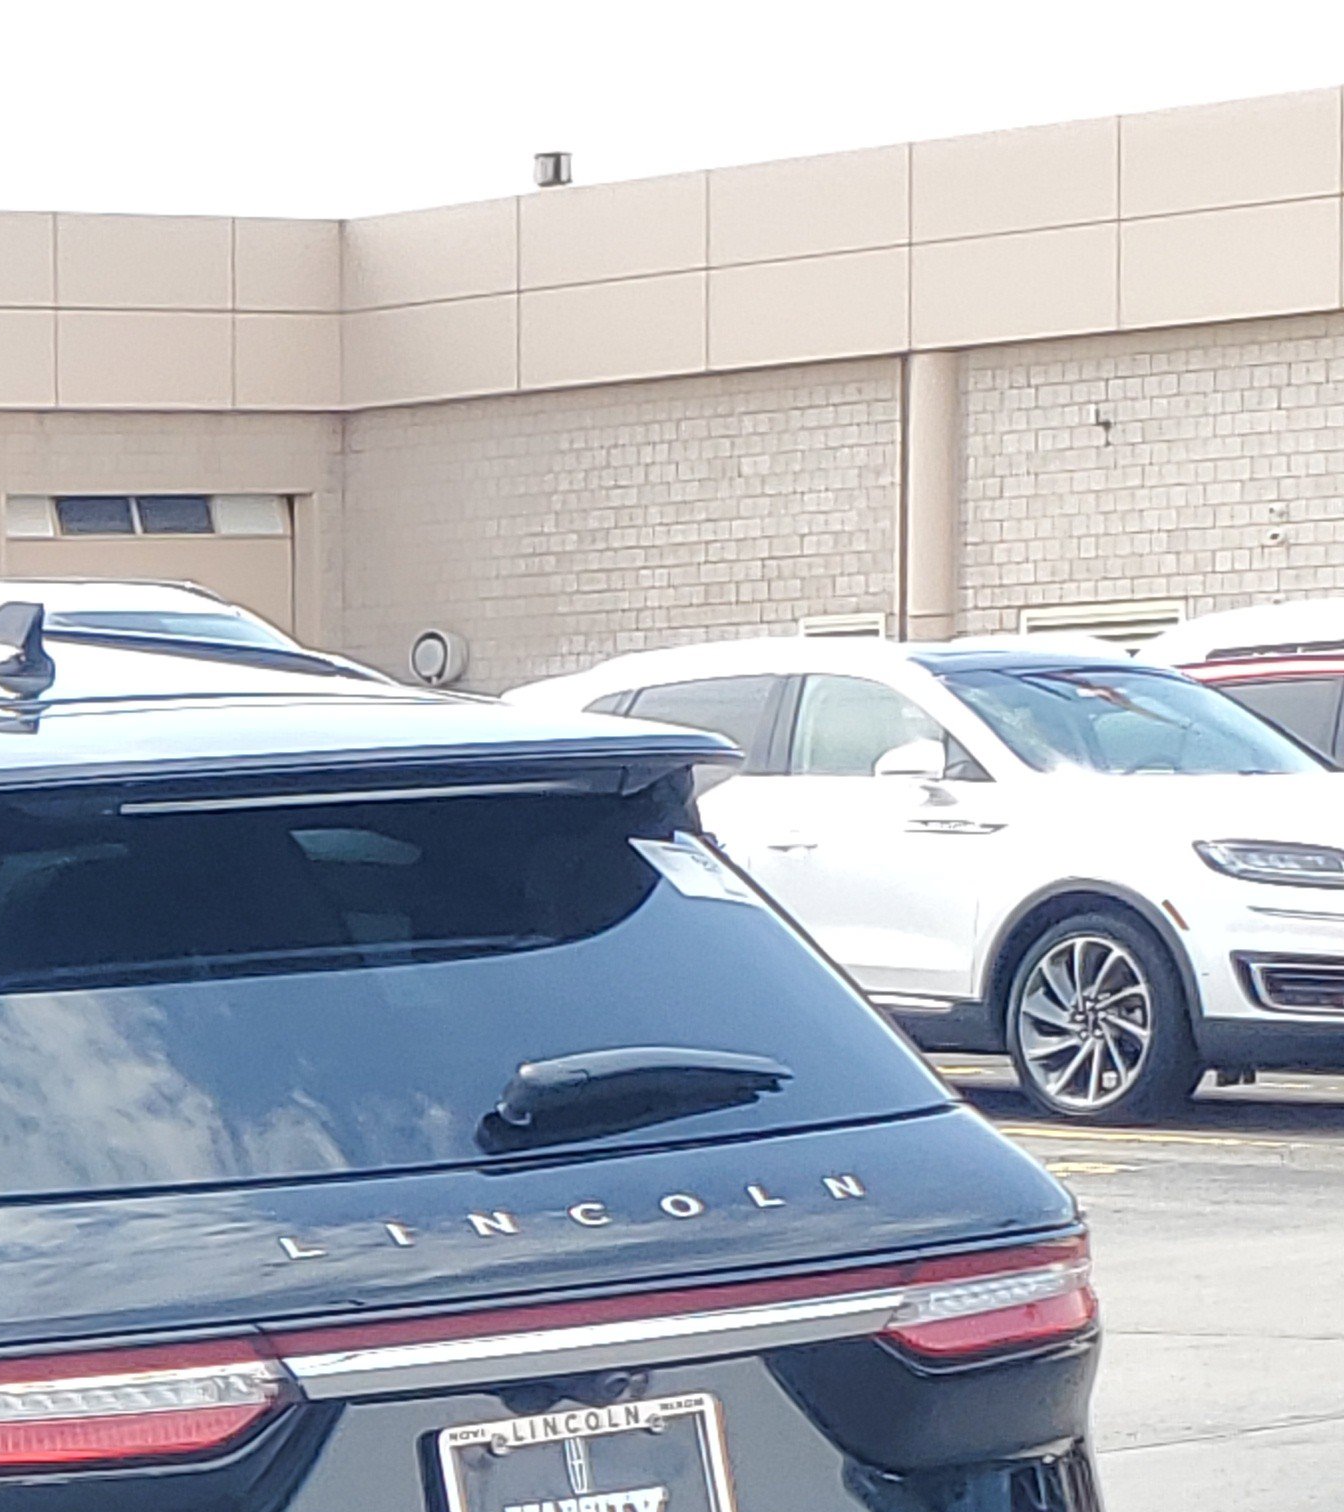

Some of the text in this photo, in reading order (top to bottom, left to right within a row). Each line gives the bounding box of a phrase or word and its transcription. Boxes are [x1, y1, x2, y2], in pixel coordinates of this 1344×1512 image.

[278, 1173, 867, 1260] LINCOLN
[449, 1428, 487, 1442] NOVI
[512, 1406, 640, 1442] LINCOLN
